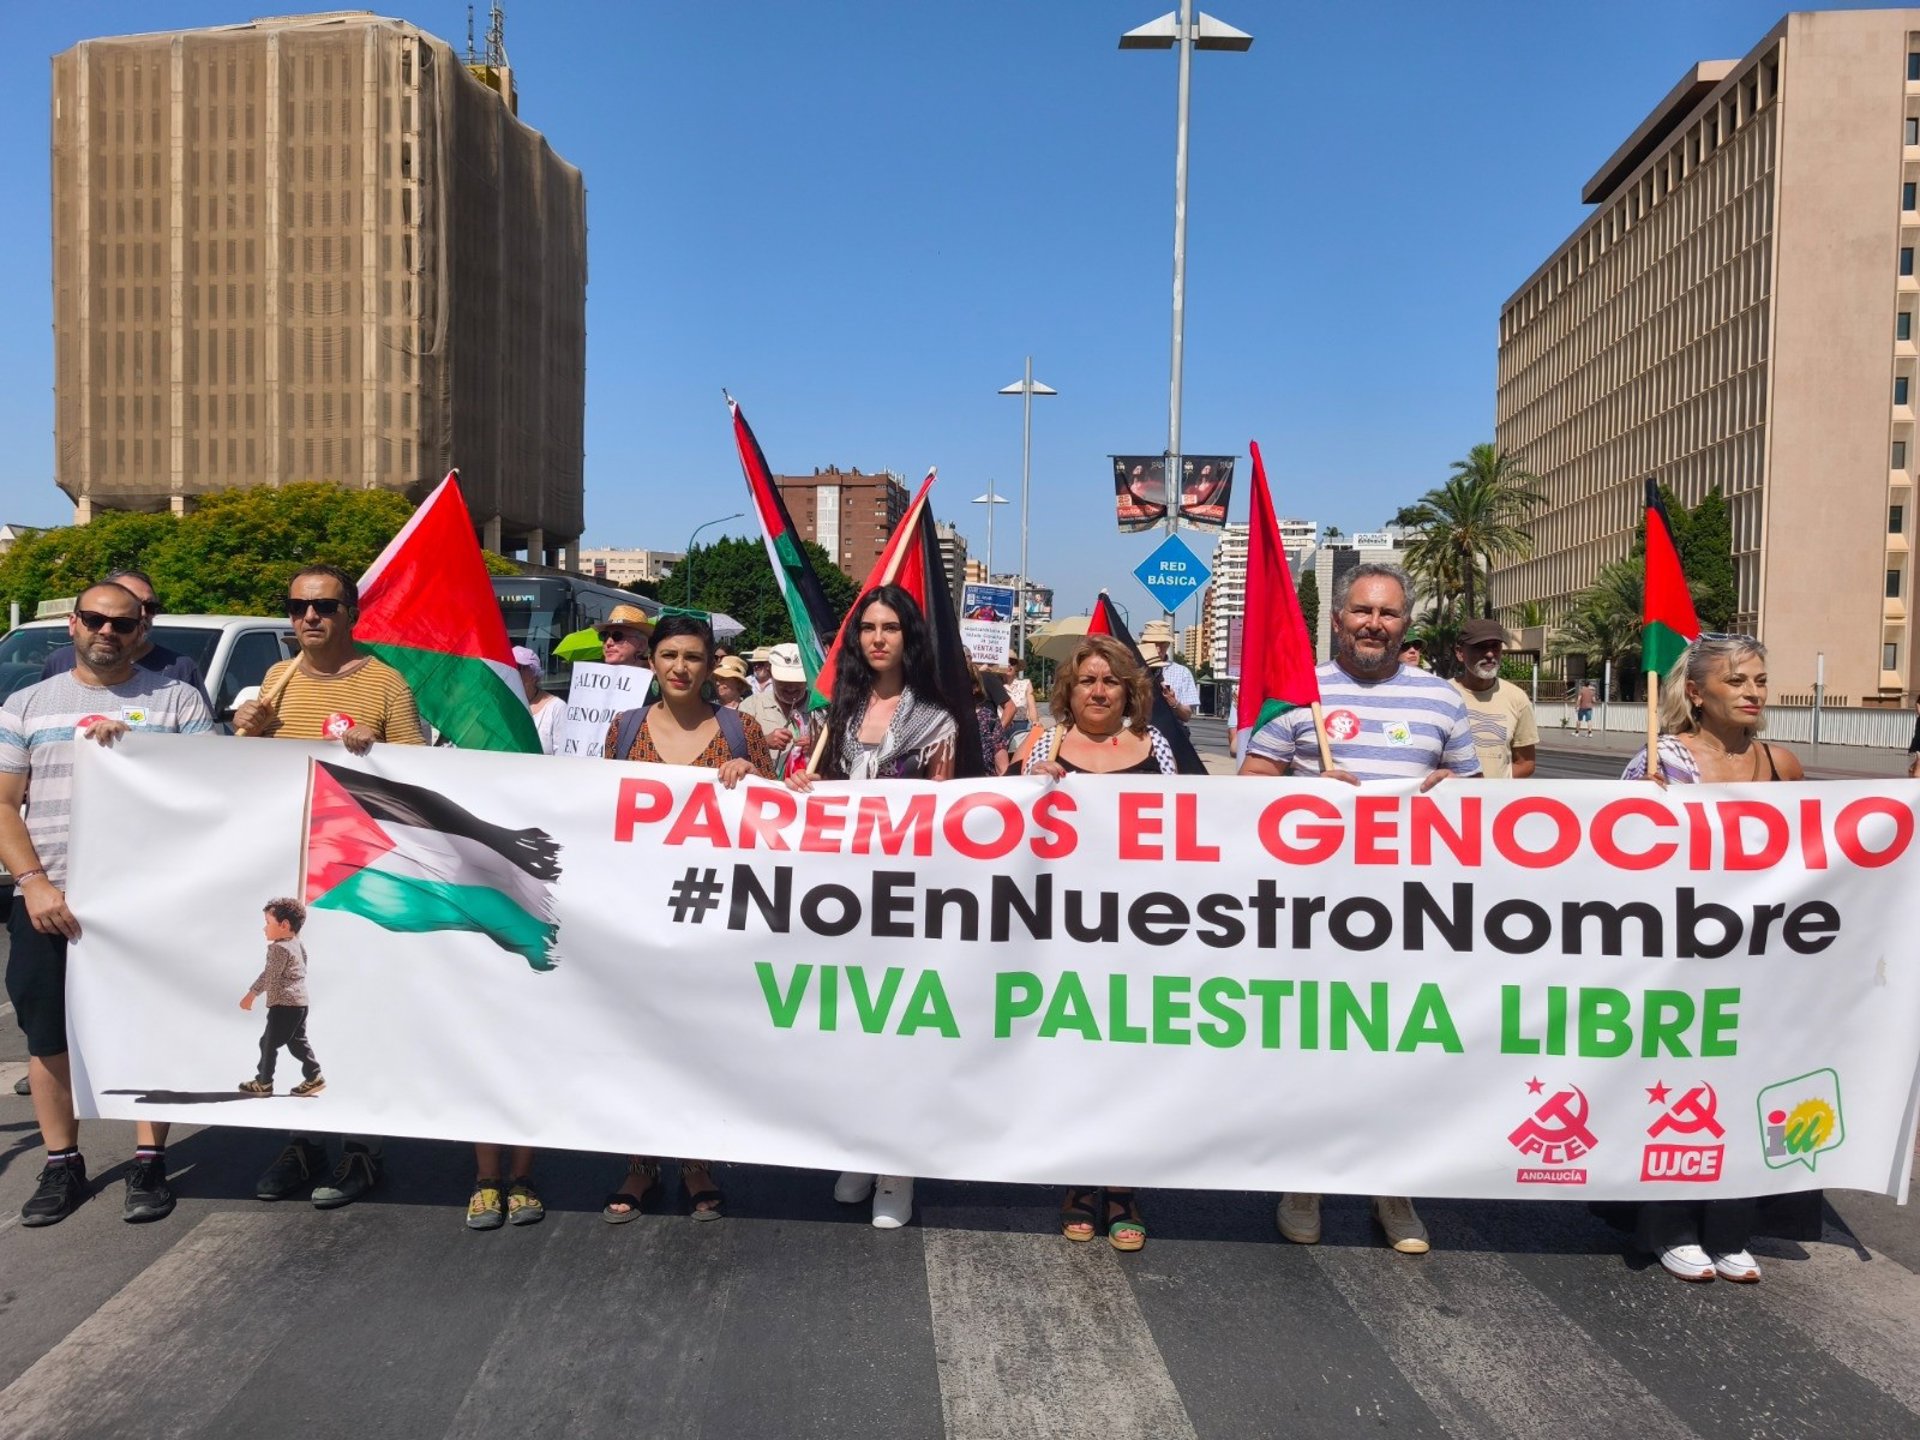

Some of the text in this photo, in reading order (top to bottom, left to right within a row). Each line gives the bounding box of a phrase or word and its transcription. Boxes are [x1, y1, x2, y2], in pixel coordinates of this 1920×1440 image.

[1159, 561, 1187, 572] RED
[1147, 574, 1197, 586] BÁSICA
[972, 652, 999, 660] NTRADAS
[616, 676, 632, 692] AL
[613, 776, 1916, 871] PAREMOS EL GENOCIDIO
[667, 864, 1841, 959] #NoEnNuestroNombre
[754, 961, 1741, 1059] VIVA PALESTINA LIBRE
[1518, 1136, 1587, 1164] PCE
[1647, 1150, 1718, 1177] UJCE
[1521, 1170, 1582, 1181] ANDALUCÍA
